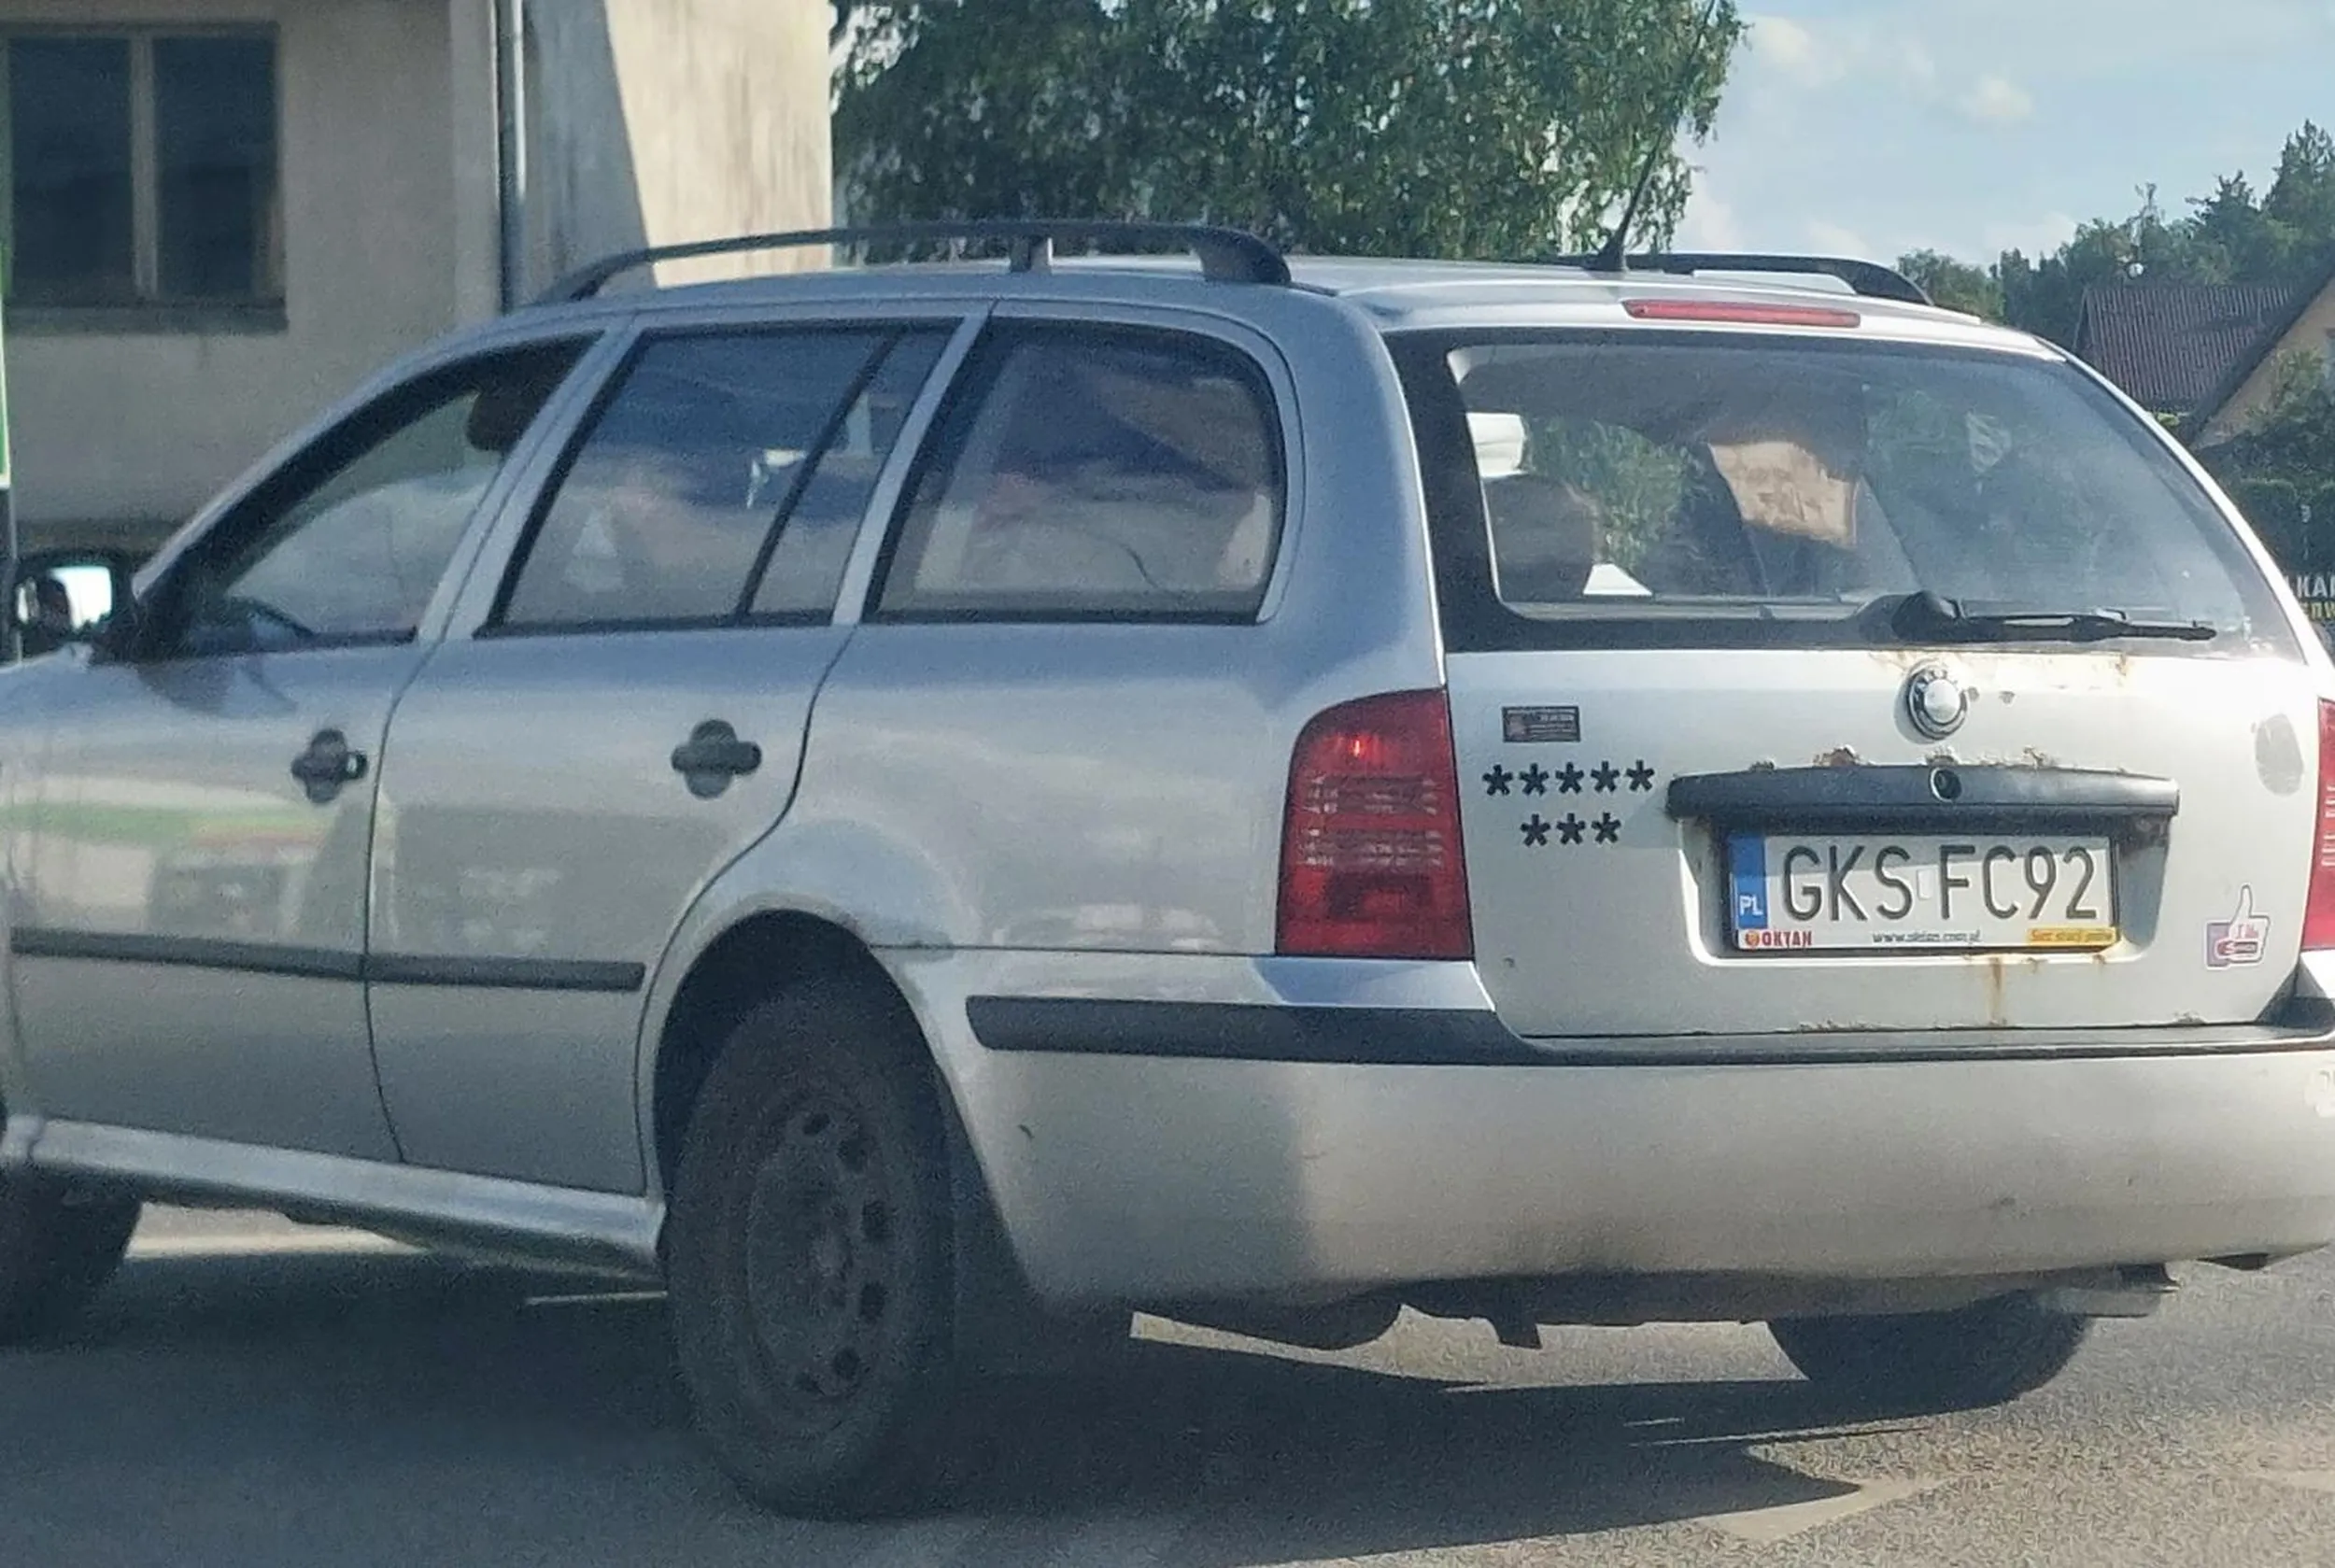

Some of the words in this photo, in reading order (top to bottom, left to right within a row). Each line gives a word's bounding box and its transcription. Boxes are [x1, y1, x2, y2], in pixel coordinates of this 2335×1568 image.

[1739, 895, 1763, 916] PL
[1783, 844, 1914, 921] GKS
[1939, 844, 2098, 921] FC92
